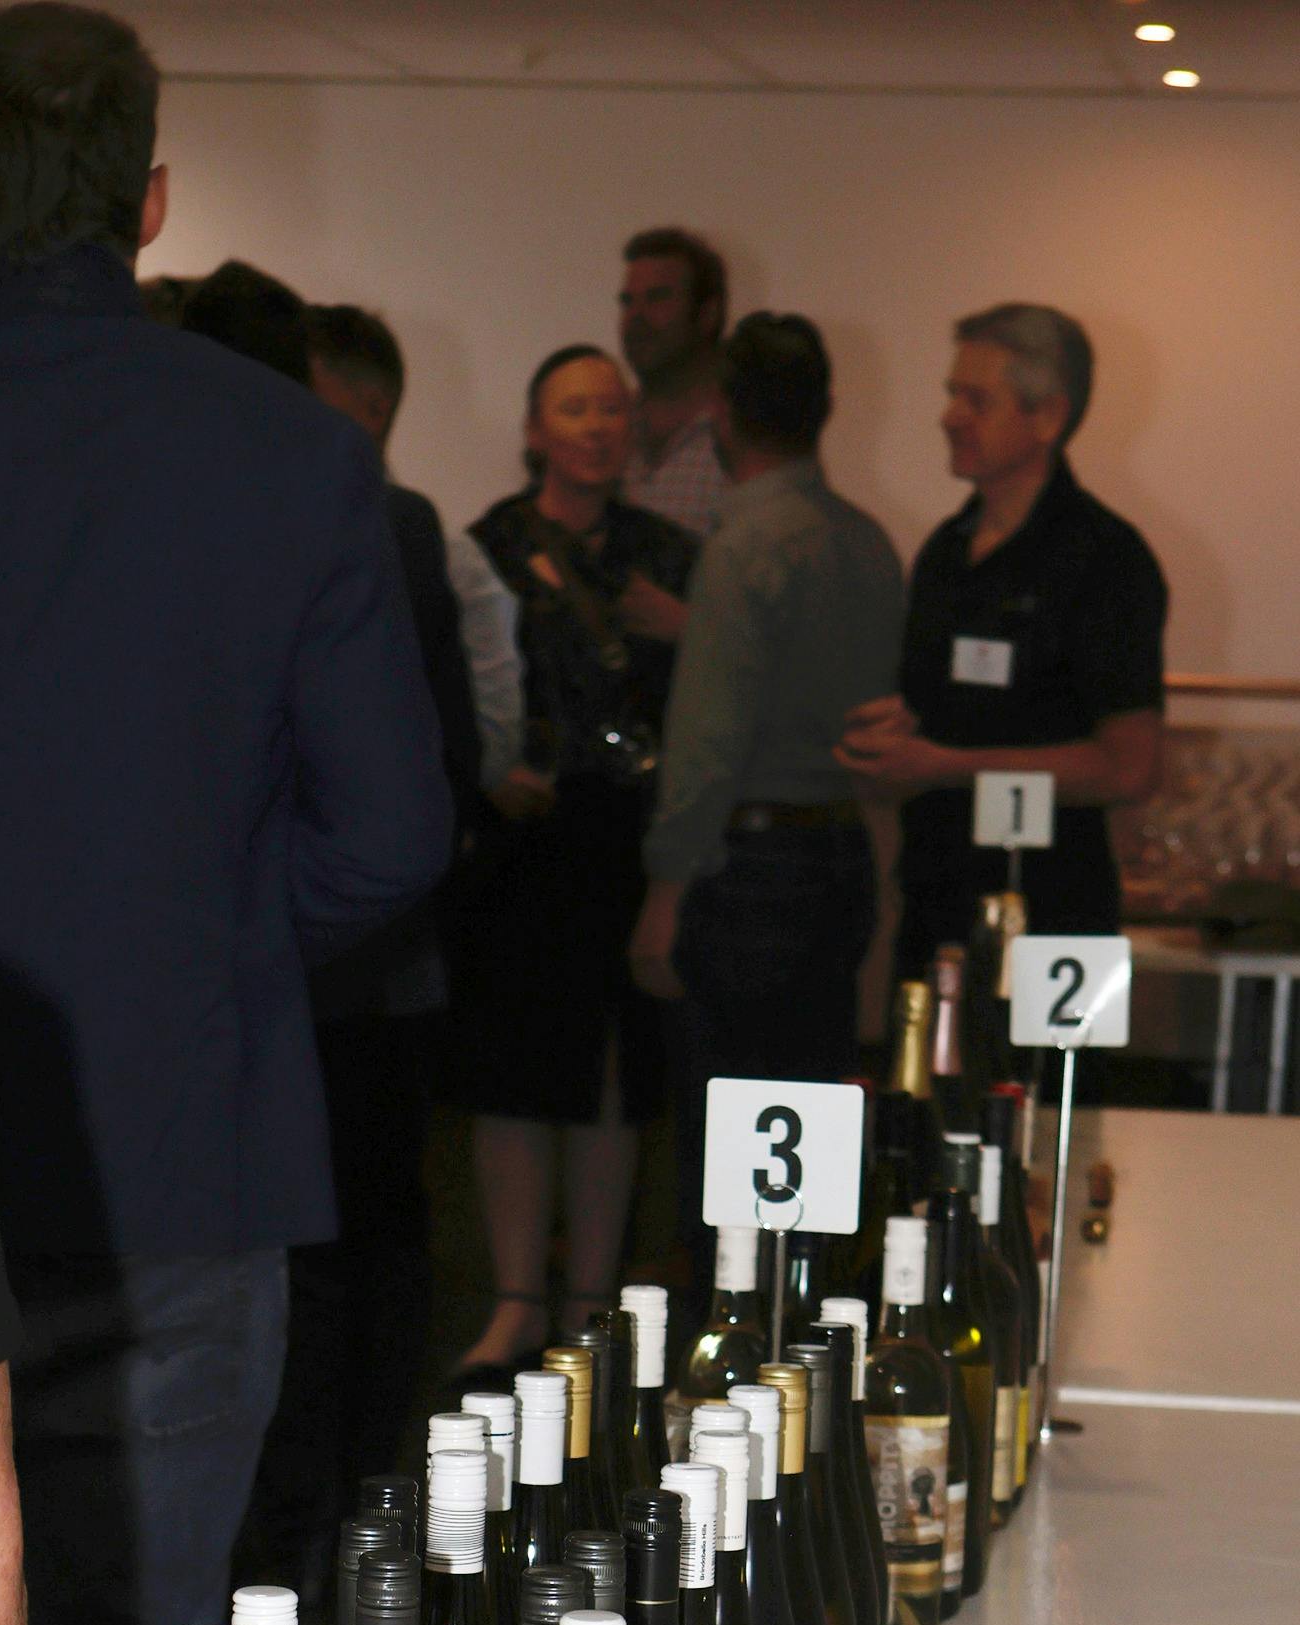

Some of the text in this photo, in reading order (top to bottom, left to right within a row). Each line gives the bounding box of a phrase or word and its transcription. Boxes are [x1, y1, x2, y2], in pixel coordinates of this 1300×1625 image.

[1008, 785, 1025, 833] 1
[1047, 957, 1087, 1028] 2
[752, 1105, 804, 1204] 3
